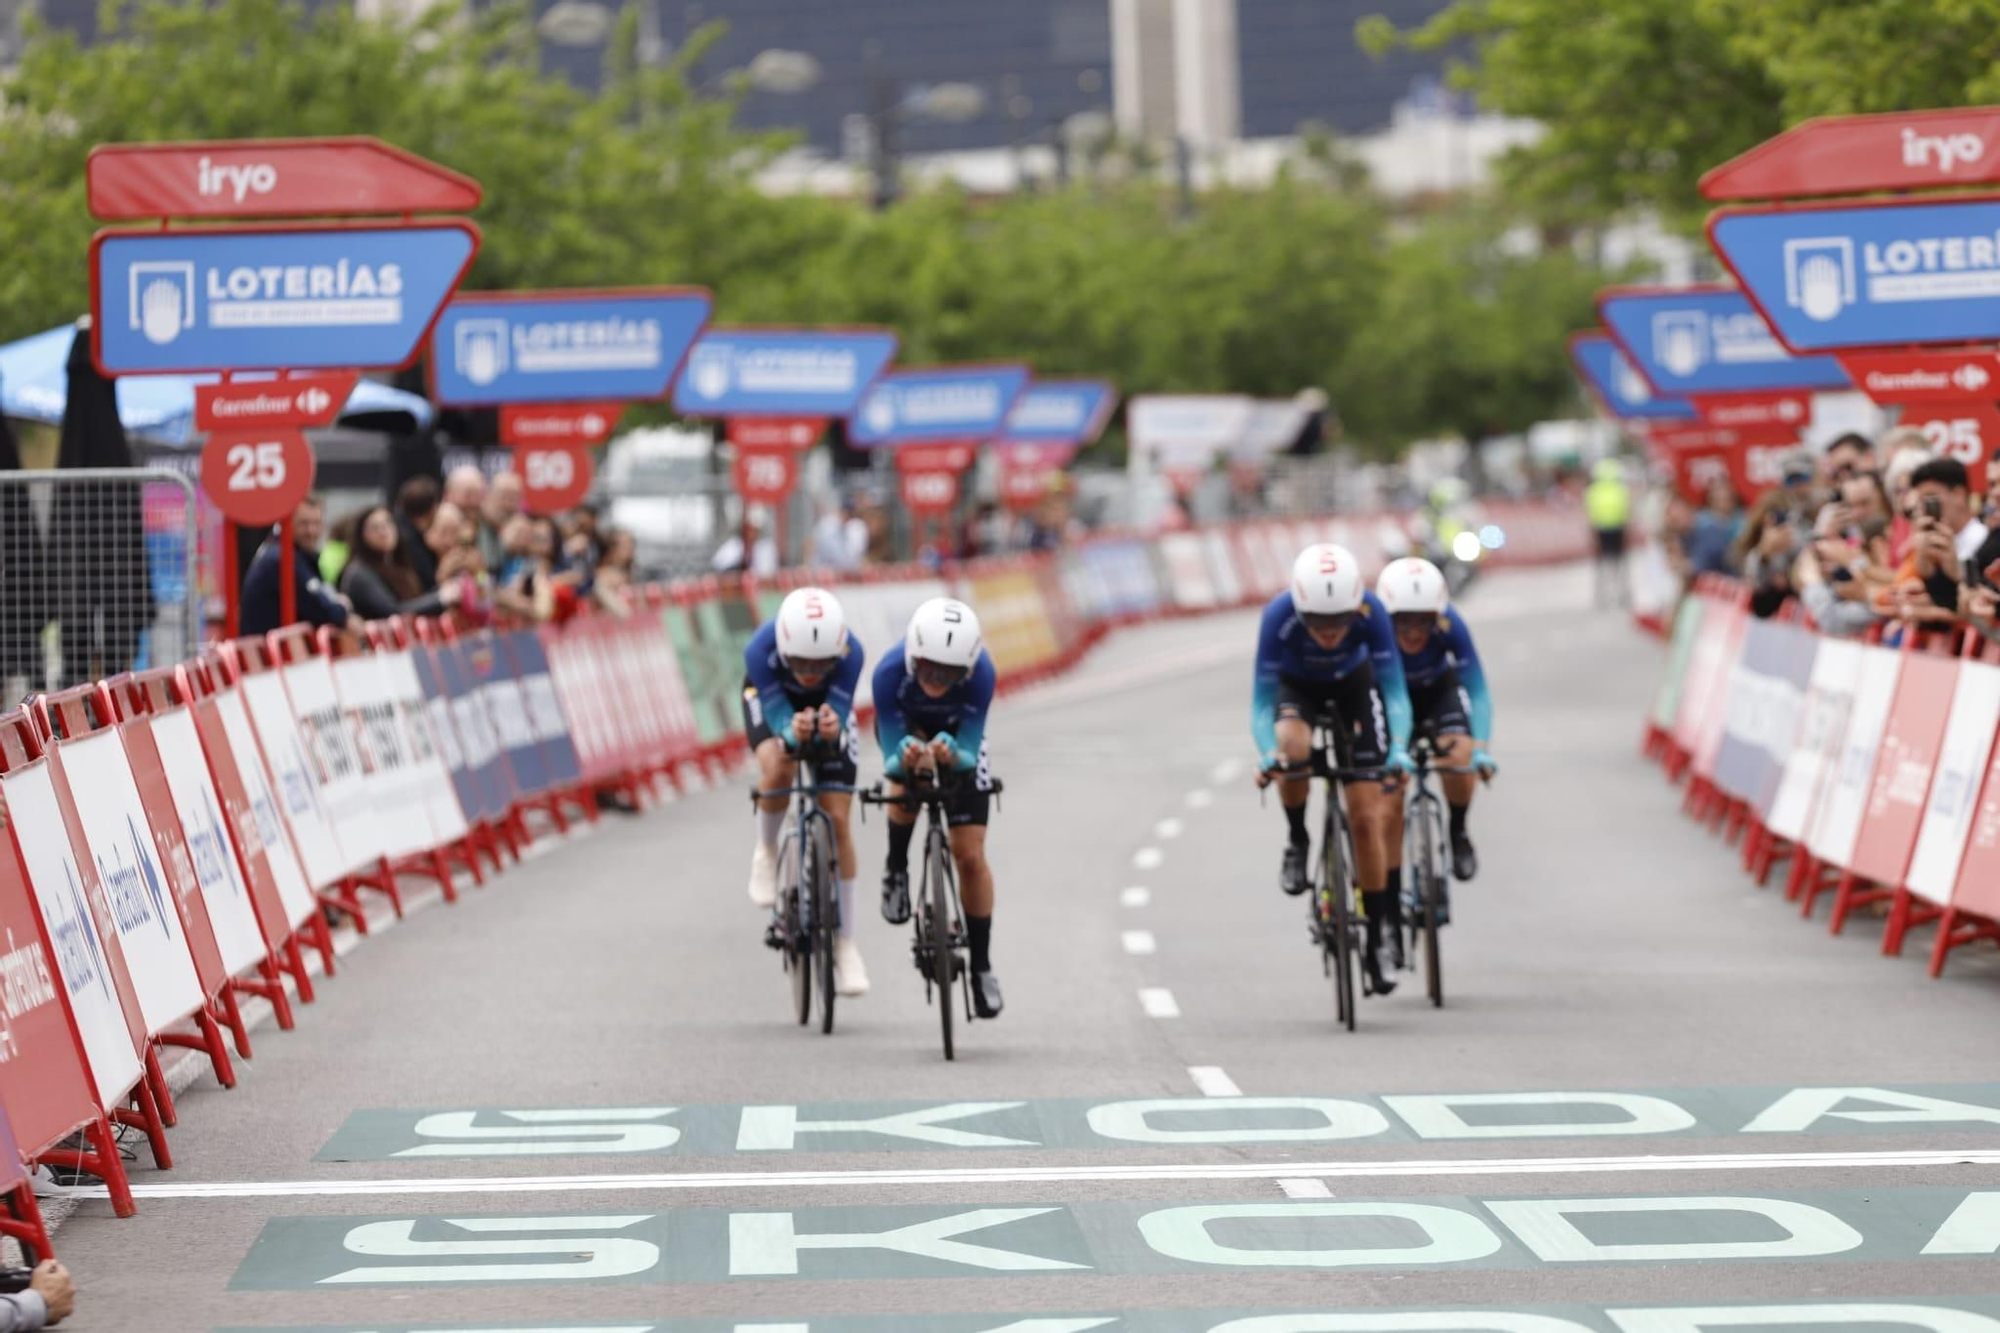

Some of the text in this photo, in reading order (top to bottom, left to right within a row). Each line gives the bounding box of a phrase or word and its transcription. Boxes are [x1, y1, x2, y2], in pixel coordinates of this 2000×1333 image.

[1902, 127, 1984, 173] iryo
[198, 157, 277, 202] iryo
[207, 258, 402, 300] LOTERÍAS
[1866, 369, 1948, 389] Carrefour
[211, 395, 292, 418] Carrefour
[226, 442, 287, 492] 25
[525, 449, 575, 490] 50
[314, 1191, 2000, 1284] SKOD
